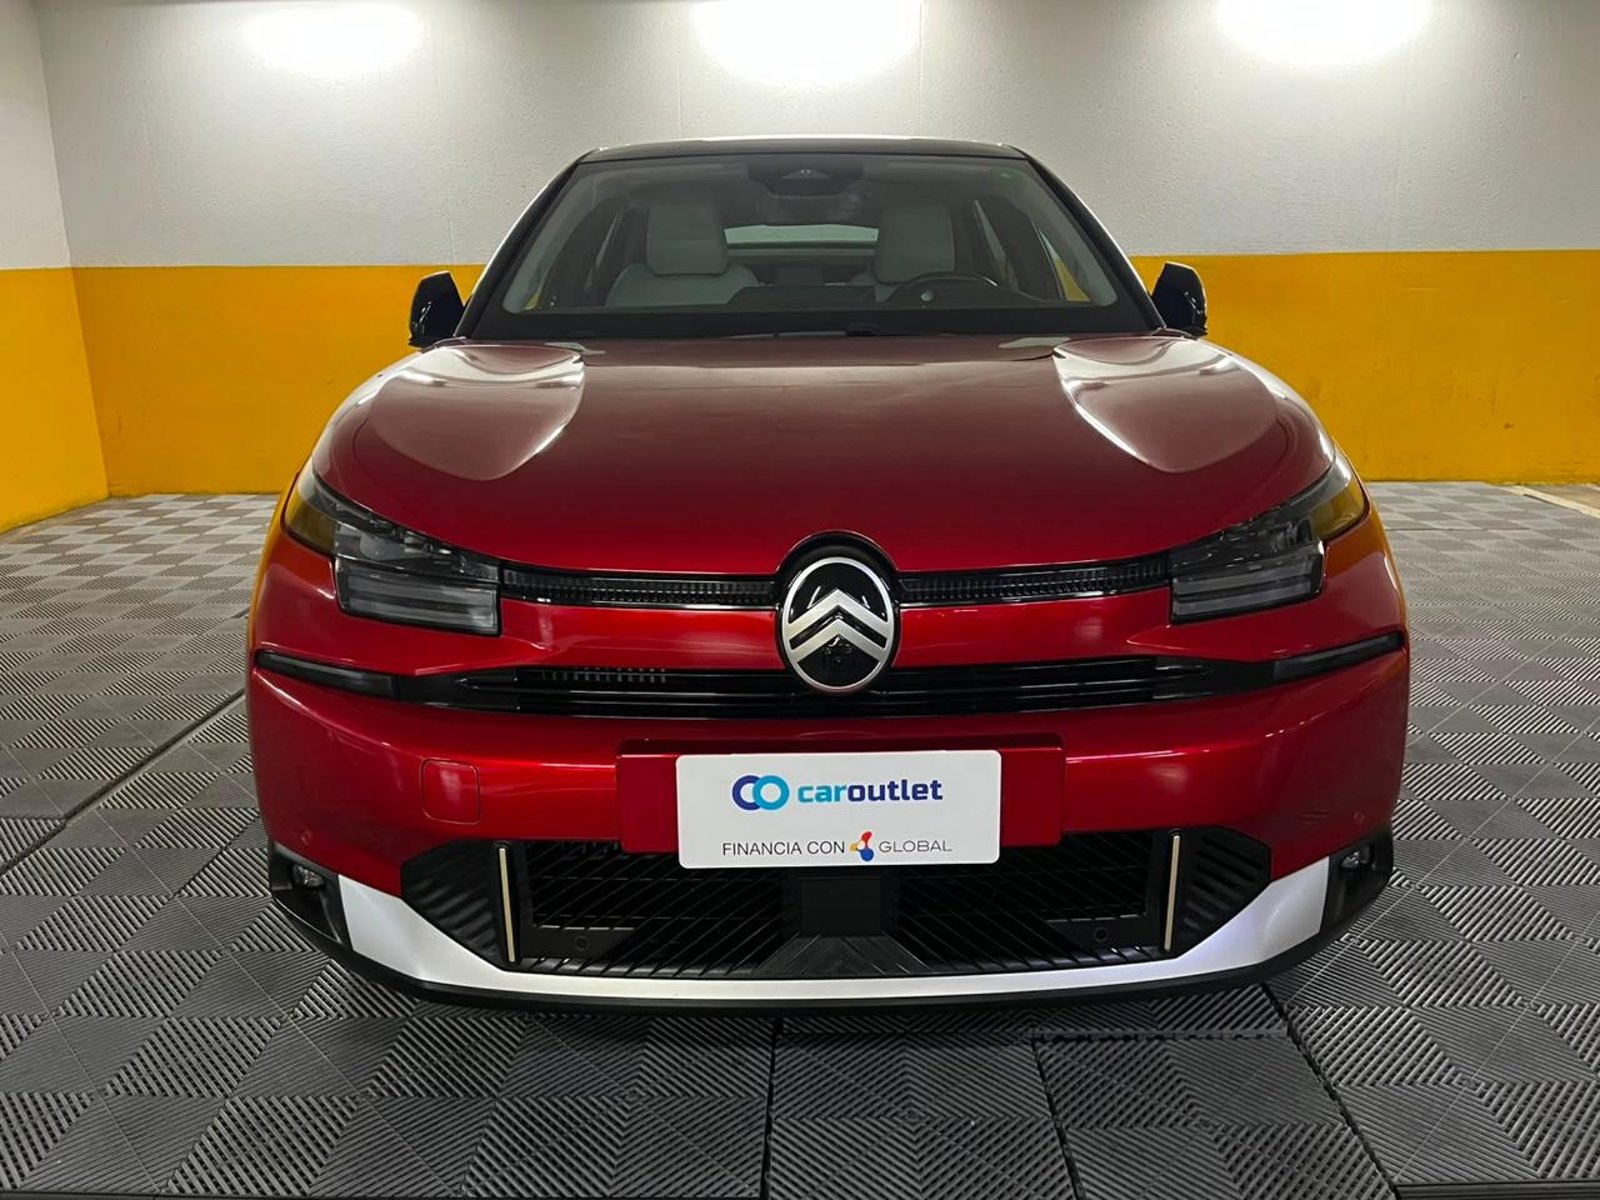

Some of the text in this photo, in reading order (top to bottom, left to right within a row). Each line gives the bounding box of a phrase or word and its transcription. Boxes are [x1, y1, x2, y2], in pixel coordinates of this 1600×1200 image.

[797, 779, 943, 803] caroutlet
[722, 840, 953, 856] FINANCIA CON GLOBAL
